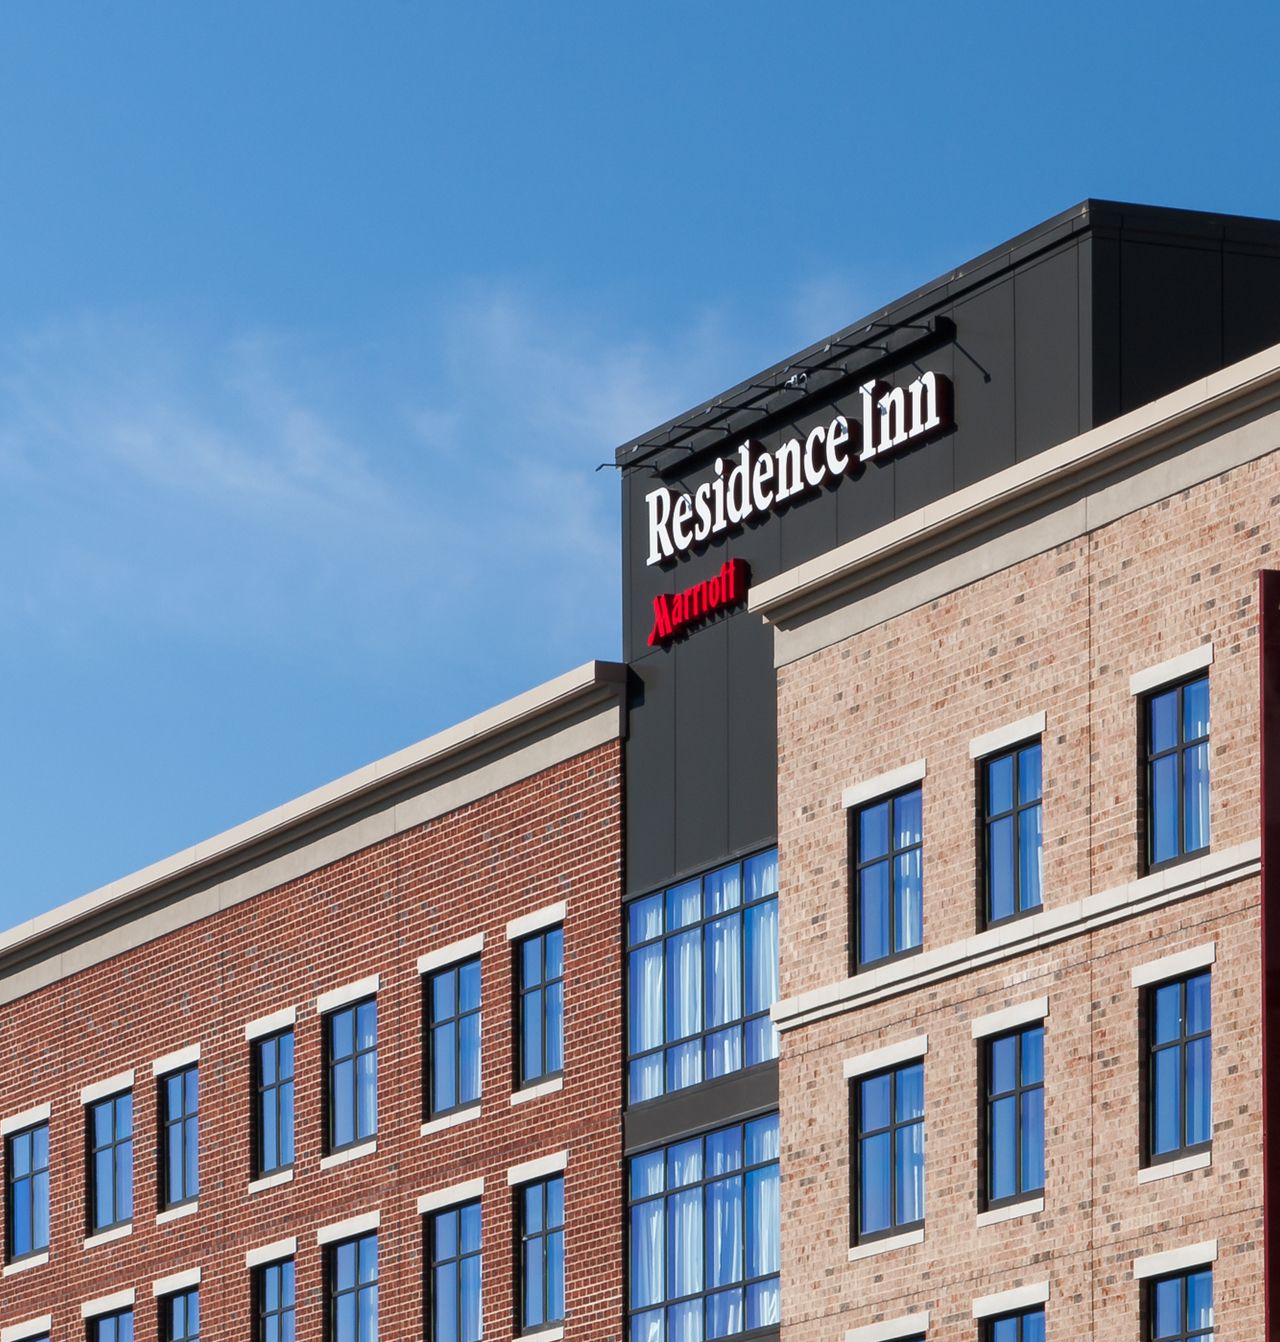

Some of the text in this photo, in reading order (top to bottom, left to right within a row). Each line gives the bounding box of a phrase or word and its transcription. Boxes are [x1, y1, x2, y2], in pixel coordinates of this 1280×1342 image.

[644, 370, 940, 567] Residence Inn
[647, 557, 746, 647] Marriott
